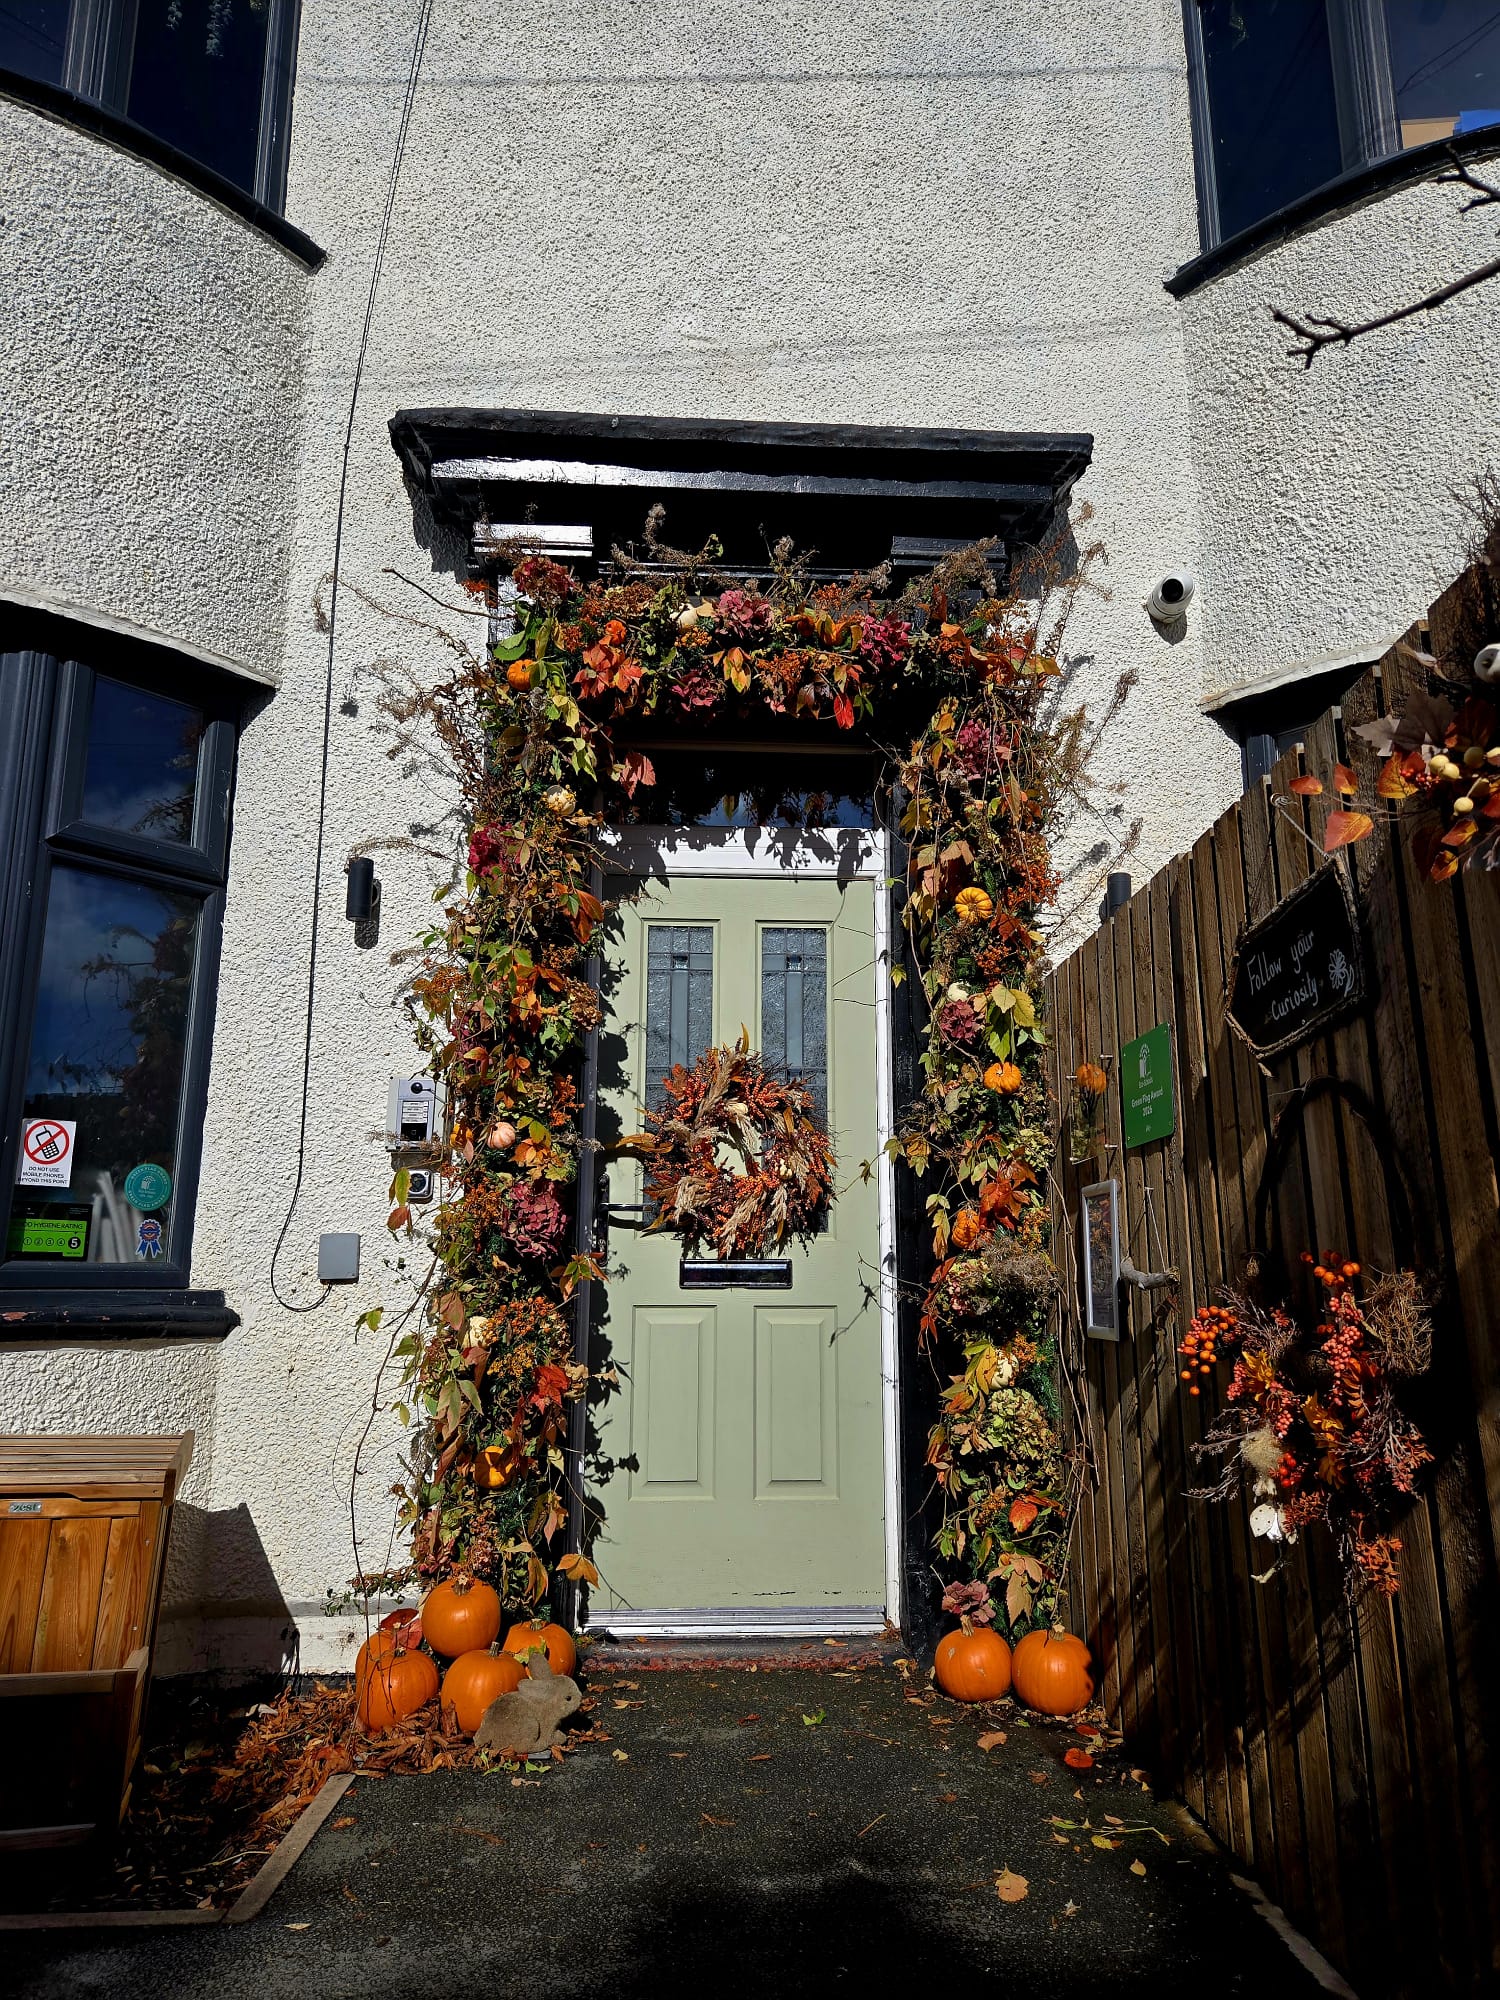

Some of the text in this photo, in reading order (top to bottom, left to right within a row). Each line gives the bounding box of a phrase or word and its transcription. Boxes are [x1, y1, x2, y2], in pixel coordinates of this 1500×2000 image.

[1247, 931, 1314, 996] Follow your
[1131, 1086, 1164, 1108] Green Flag Award
[70, 1238, 78, 1248] 5
